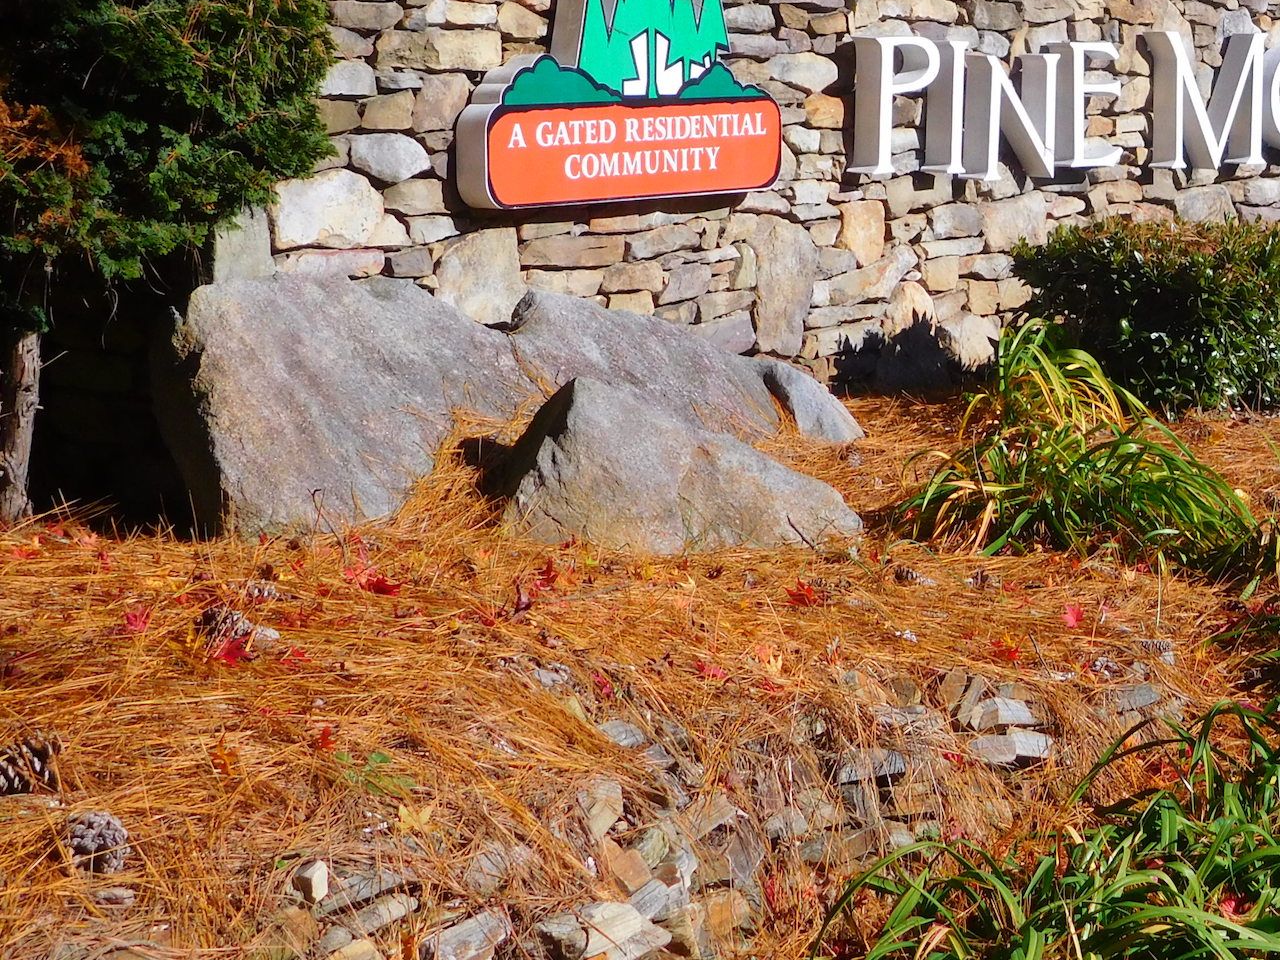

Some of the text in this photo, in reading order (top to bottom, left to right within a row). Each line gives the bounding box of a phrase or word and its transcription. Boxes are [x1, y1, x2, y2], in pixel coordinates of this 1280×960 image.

[872, 35, 1124, 182] PINE
[507, 111, 767, 149] A GATED RESIDENTIAL
[563, 146, 721, 180] COMMUNITY
